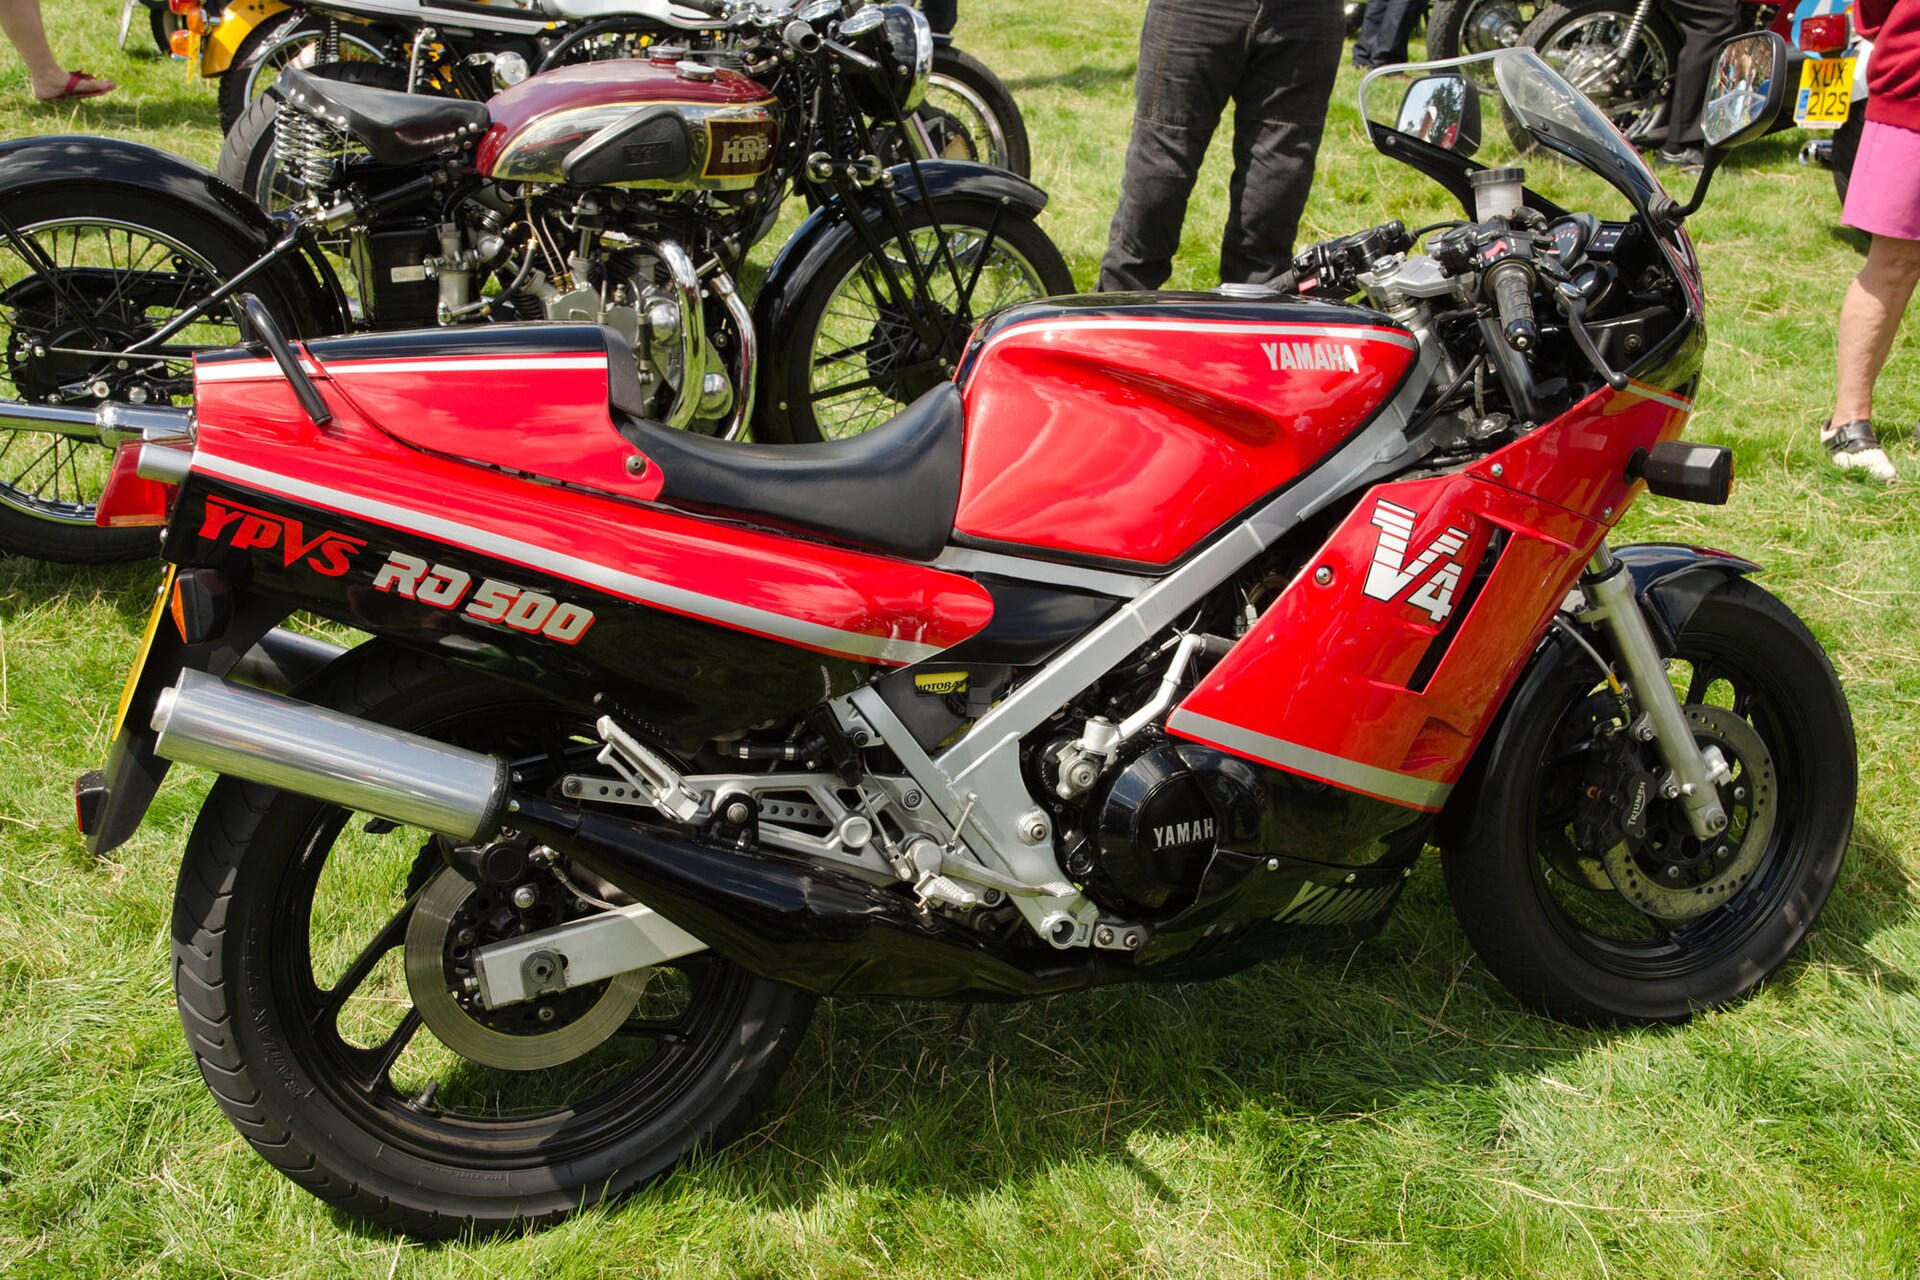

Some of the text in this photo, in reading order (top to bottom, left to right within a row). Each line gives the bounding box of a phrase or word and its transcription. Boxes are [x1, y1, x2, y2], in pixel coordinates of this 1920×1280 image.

[1810, 62, 1848, 87] XUX
[1808, 91, 1848, 116] 212S
[1260, 342, 1359, 374] YAMAHA
[198, 494, 368, 577] YPVS
[1361, 497, 1471, 623] V4
[372, 550, 596, 645] RD 500
[1627, 781, 1646, 827] TRIUMPH
[1153, 817, 1214, 849] YAMAH
